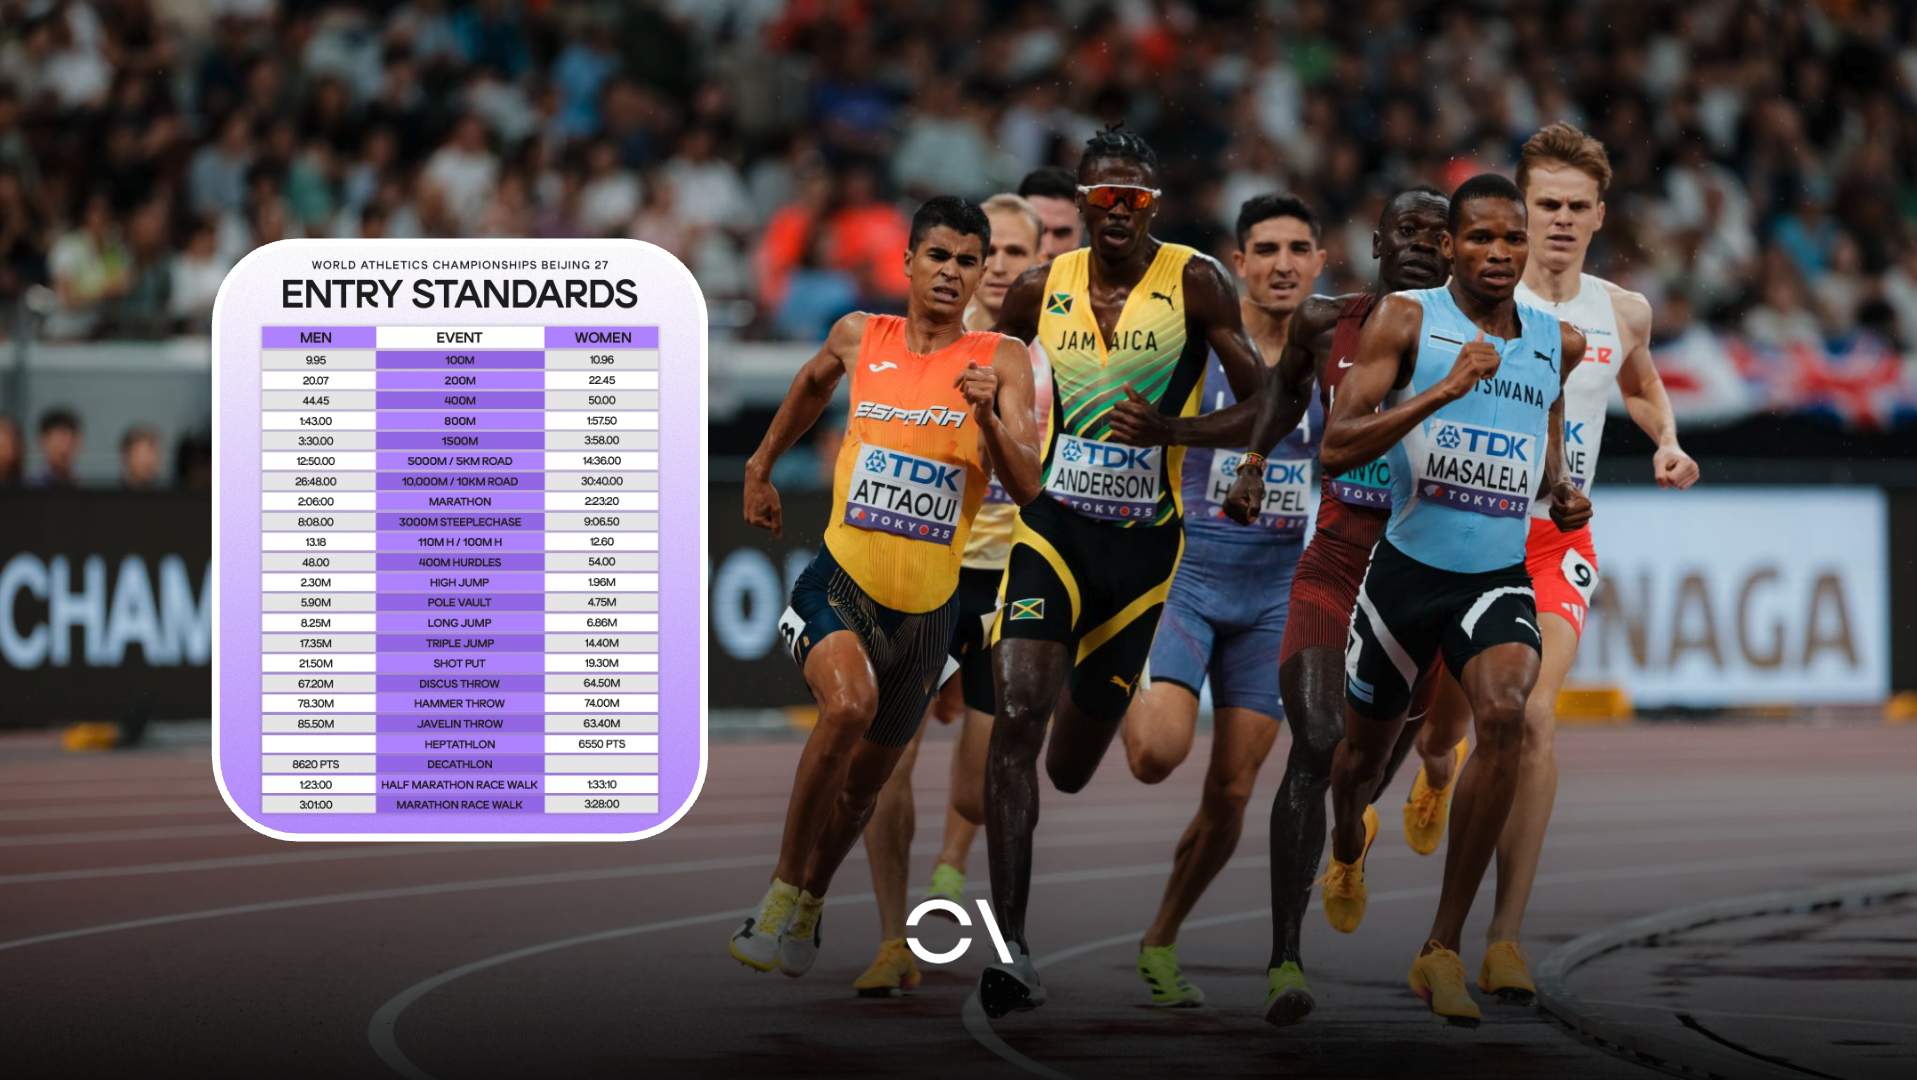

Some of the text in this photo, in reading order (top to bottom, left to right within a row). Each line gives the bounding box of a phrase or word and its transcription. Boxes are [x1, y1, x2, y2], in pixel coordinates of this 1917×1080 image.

[1057, 330, 1158, 352] JAMAICA
[1474, 377, 1544, 409] TSWANA
[854, 401, 967, 428] ESPAÑA
[1083, 442, 1154, 470] TDK
[1462, 427, 1528, 462] TDK
[888, 453, 961, 492] TDK
[1053, 467, 1155, 499] ANDERSON
[1265, 463, 1306, 485] DK
[1426, 453, 1528, 494] MASALELA
[853, 479, 957, 522] ATTAOUI
